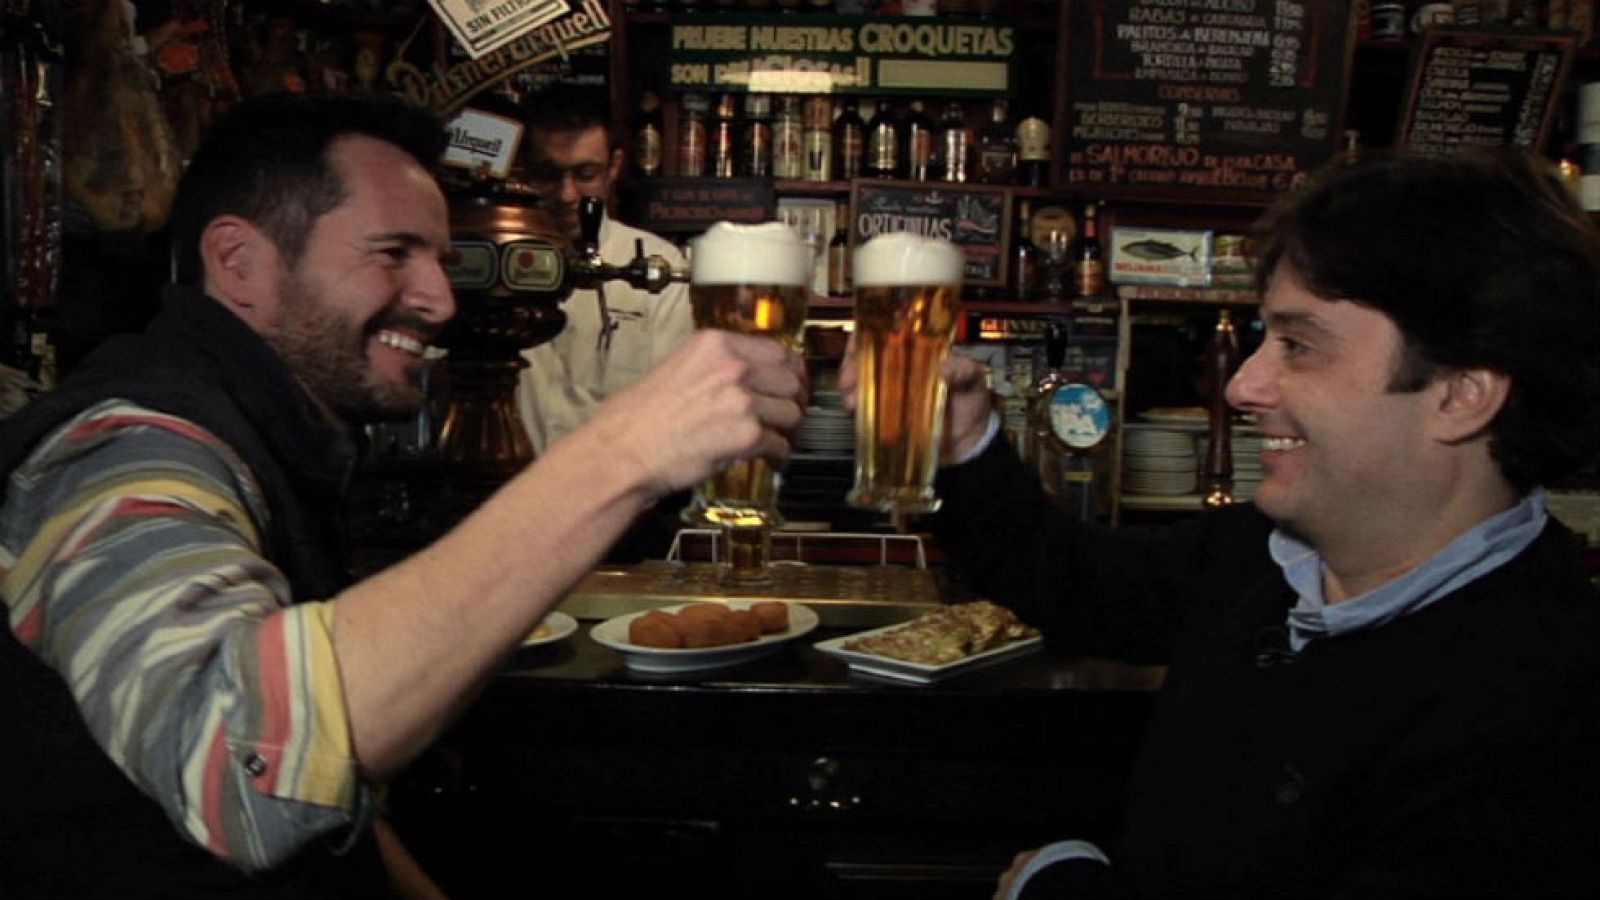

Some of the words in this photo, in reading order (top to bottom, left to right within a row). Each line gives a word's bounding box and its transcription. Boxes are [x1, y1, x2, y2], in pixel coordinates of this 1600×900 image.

[466, 15, 492, 35] SIN
[672, 25, 747, 50] PRUEBE
[751, 25, 854, 52] NUESTRAS
[858, 22, 1015, 55] CROQUETAS
[670, 62, 709, 85] SON
[1085, 144, 1200, 168] SALMOREJO
